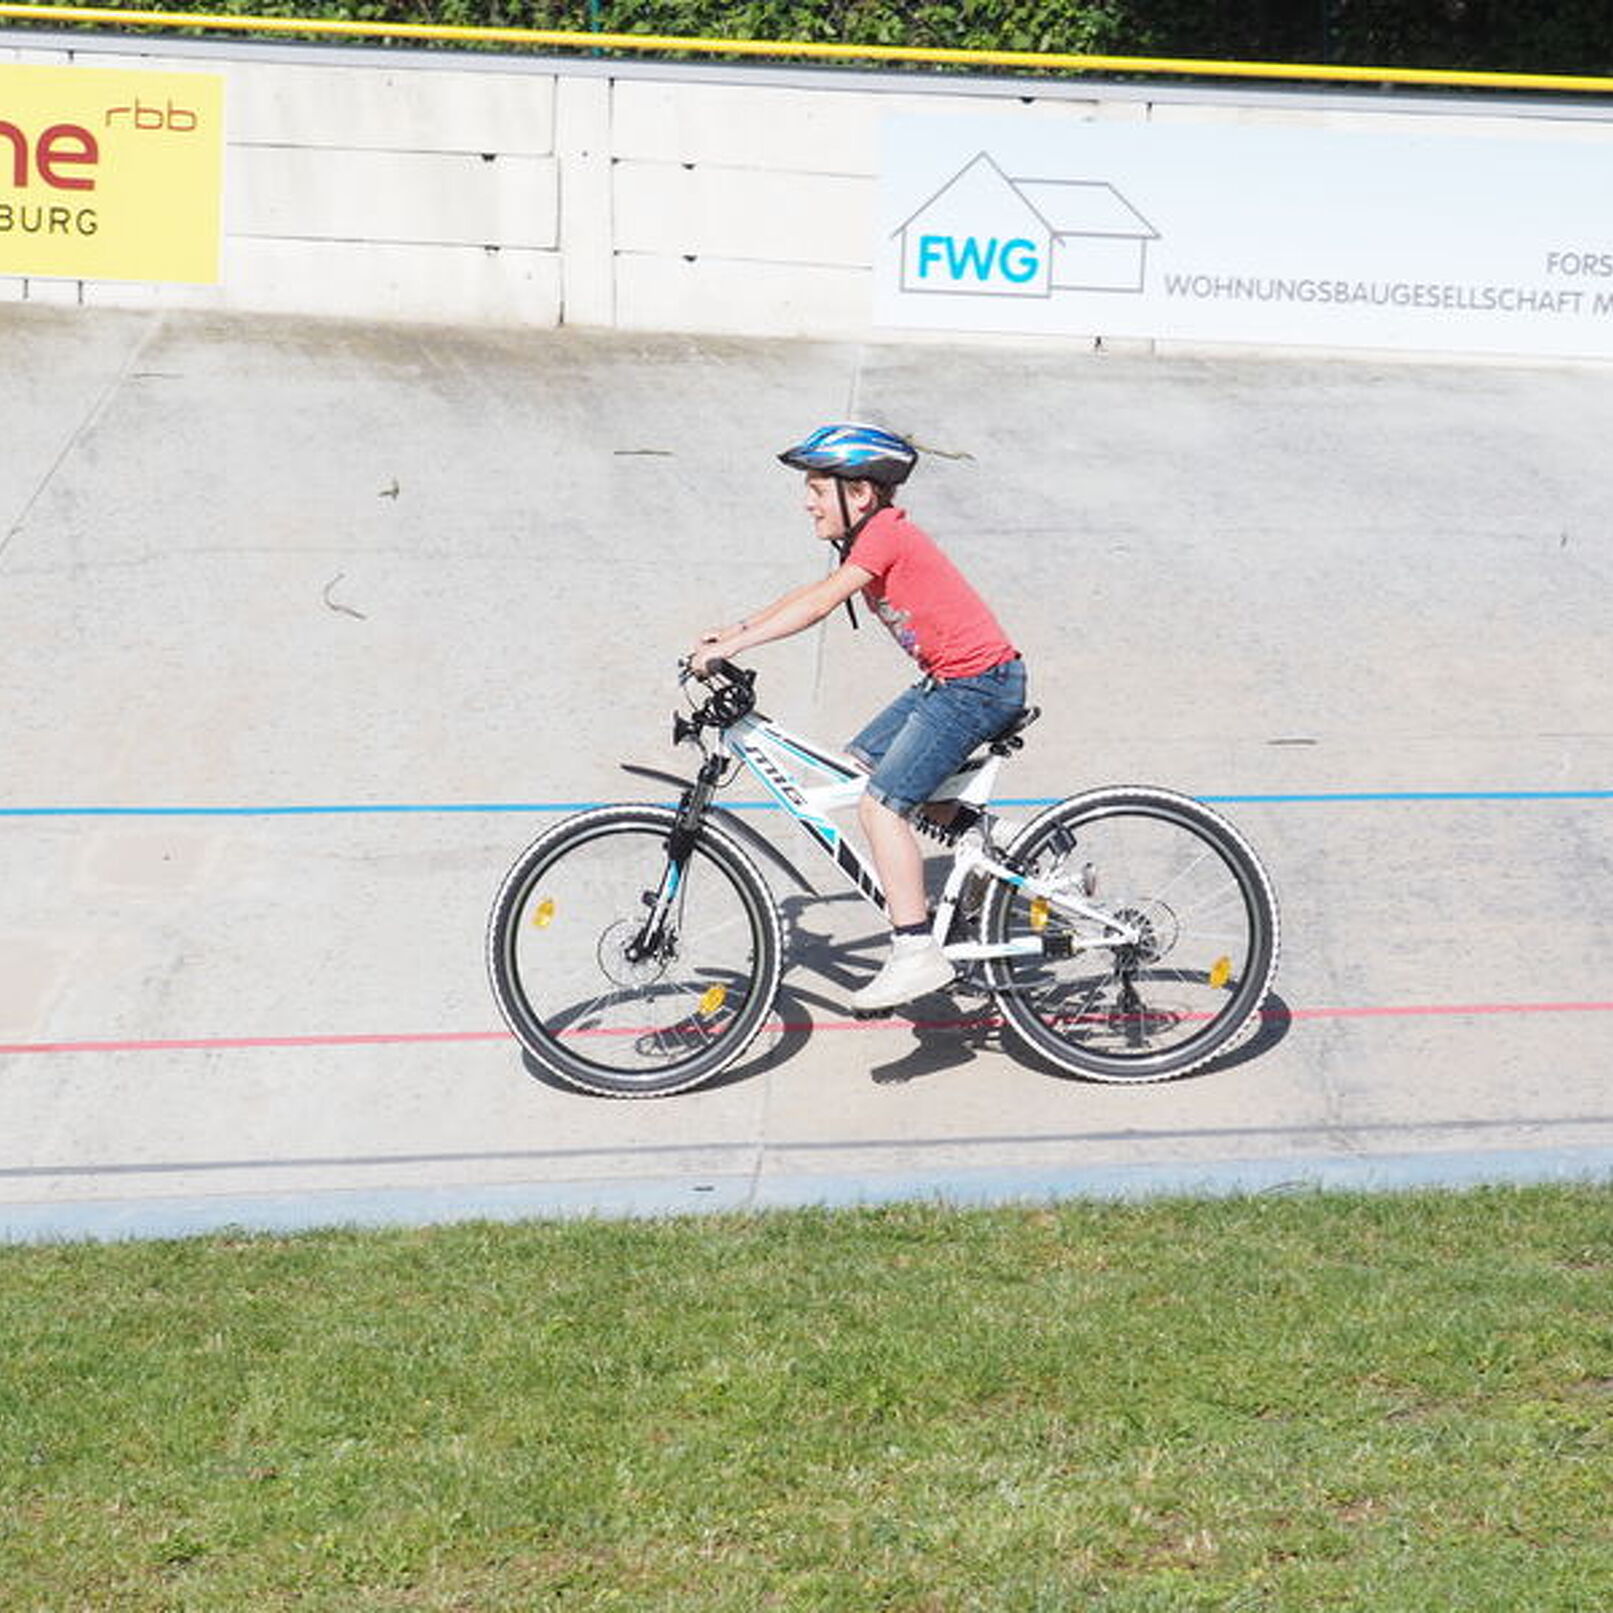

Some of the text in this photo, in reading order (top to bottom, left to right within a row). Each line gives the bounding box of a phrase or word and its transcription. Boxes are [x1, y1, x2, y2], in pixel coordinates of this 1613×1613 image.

[106, 97, 197, 131] rbb
[0, 204, 98, 236] BURG
[919, 235, 1039, 283] FWG
[1546, 251, 1613, 277] FORS
[1164, 274, 1584, 313] WOHNUNGSBAUGESELLSCHAFT
